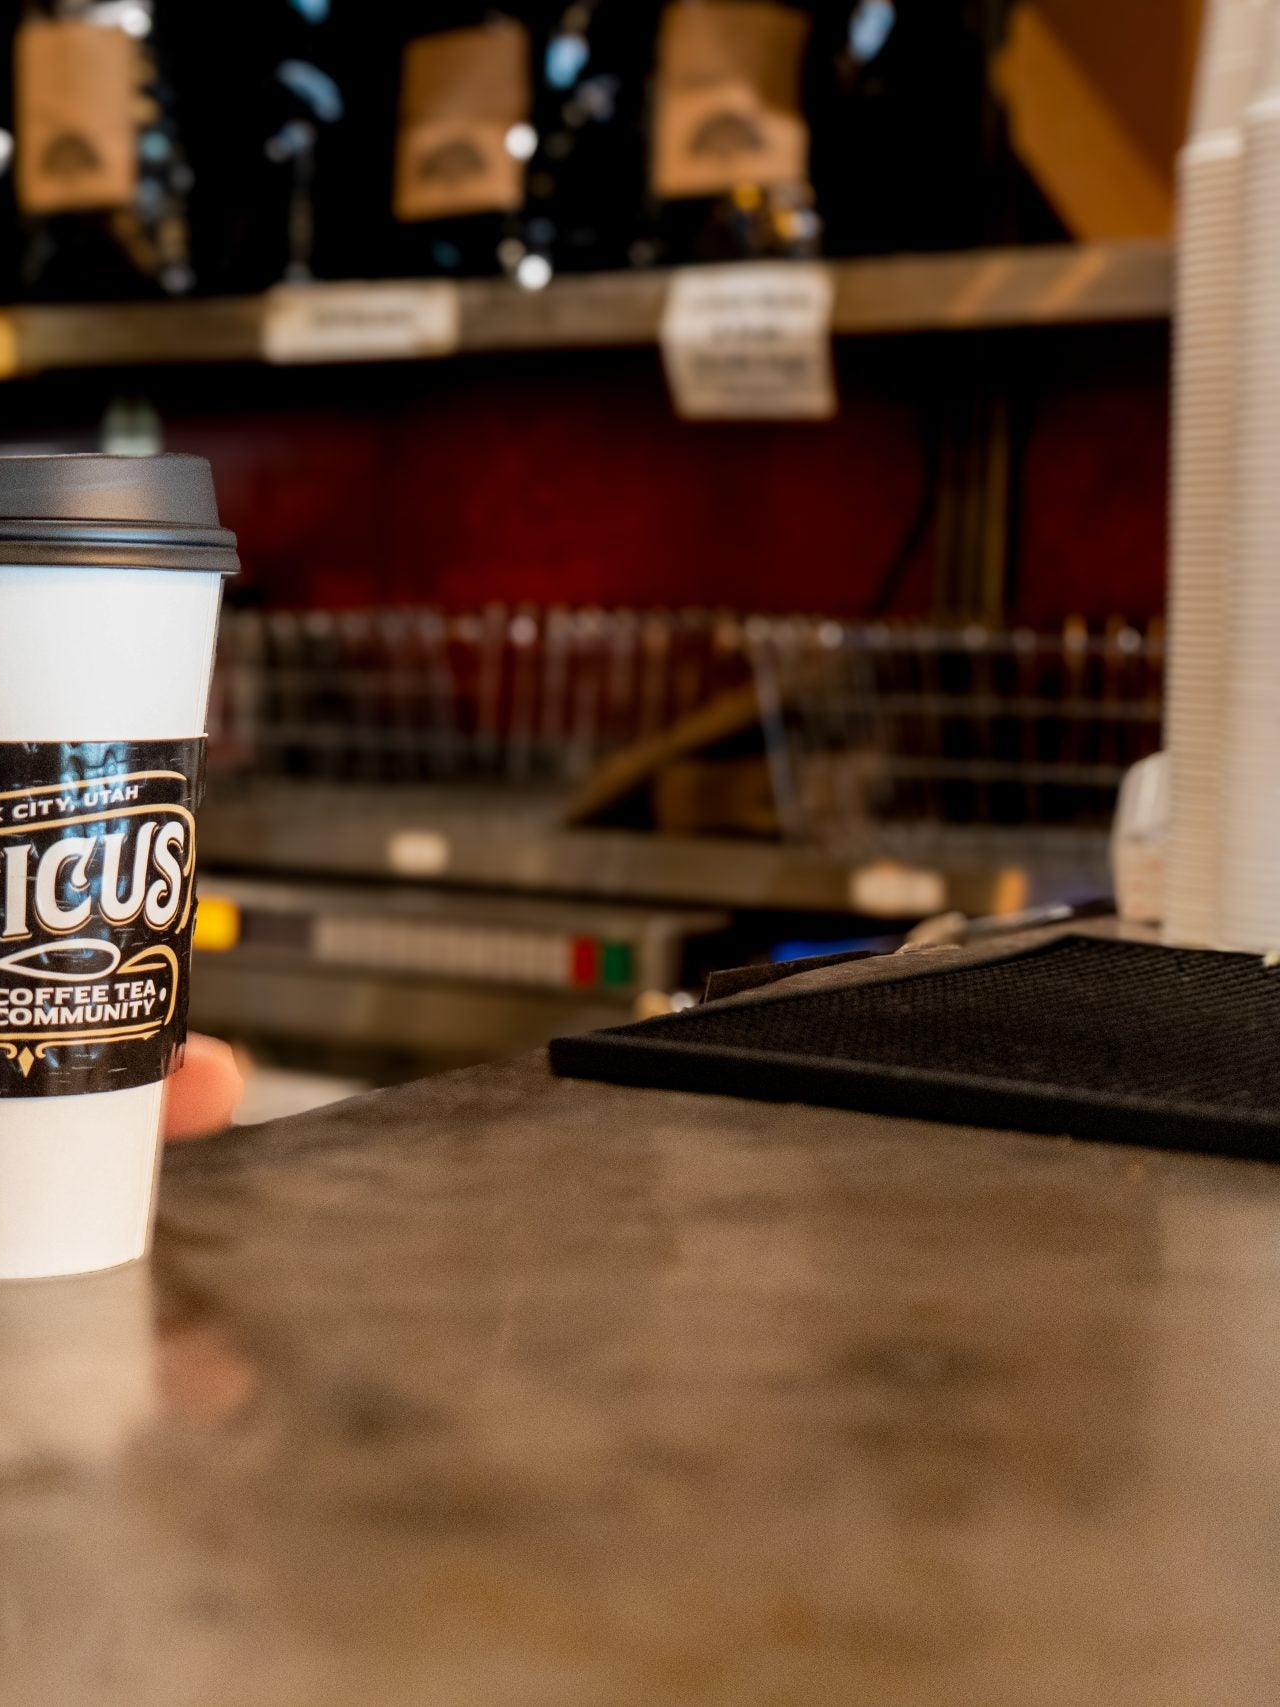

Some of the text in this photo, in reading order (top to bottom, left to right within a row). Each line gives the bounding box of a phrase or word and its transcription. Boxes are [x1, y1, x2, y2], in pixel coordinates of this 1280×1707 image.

[12, 796, 75, 820] CITY,
[83, 784, 139, 807] UTAH
[114, 979, 156, 1000] TEA
